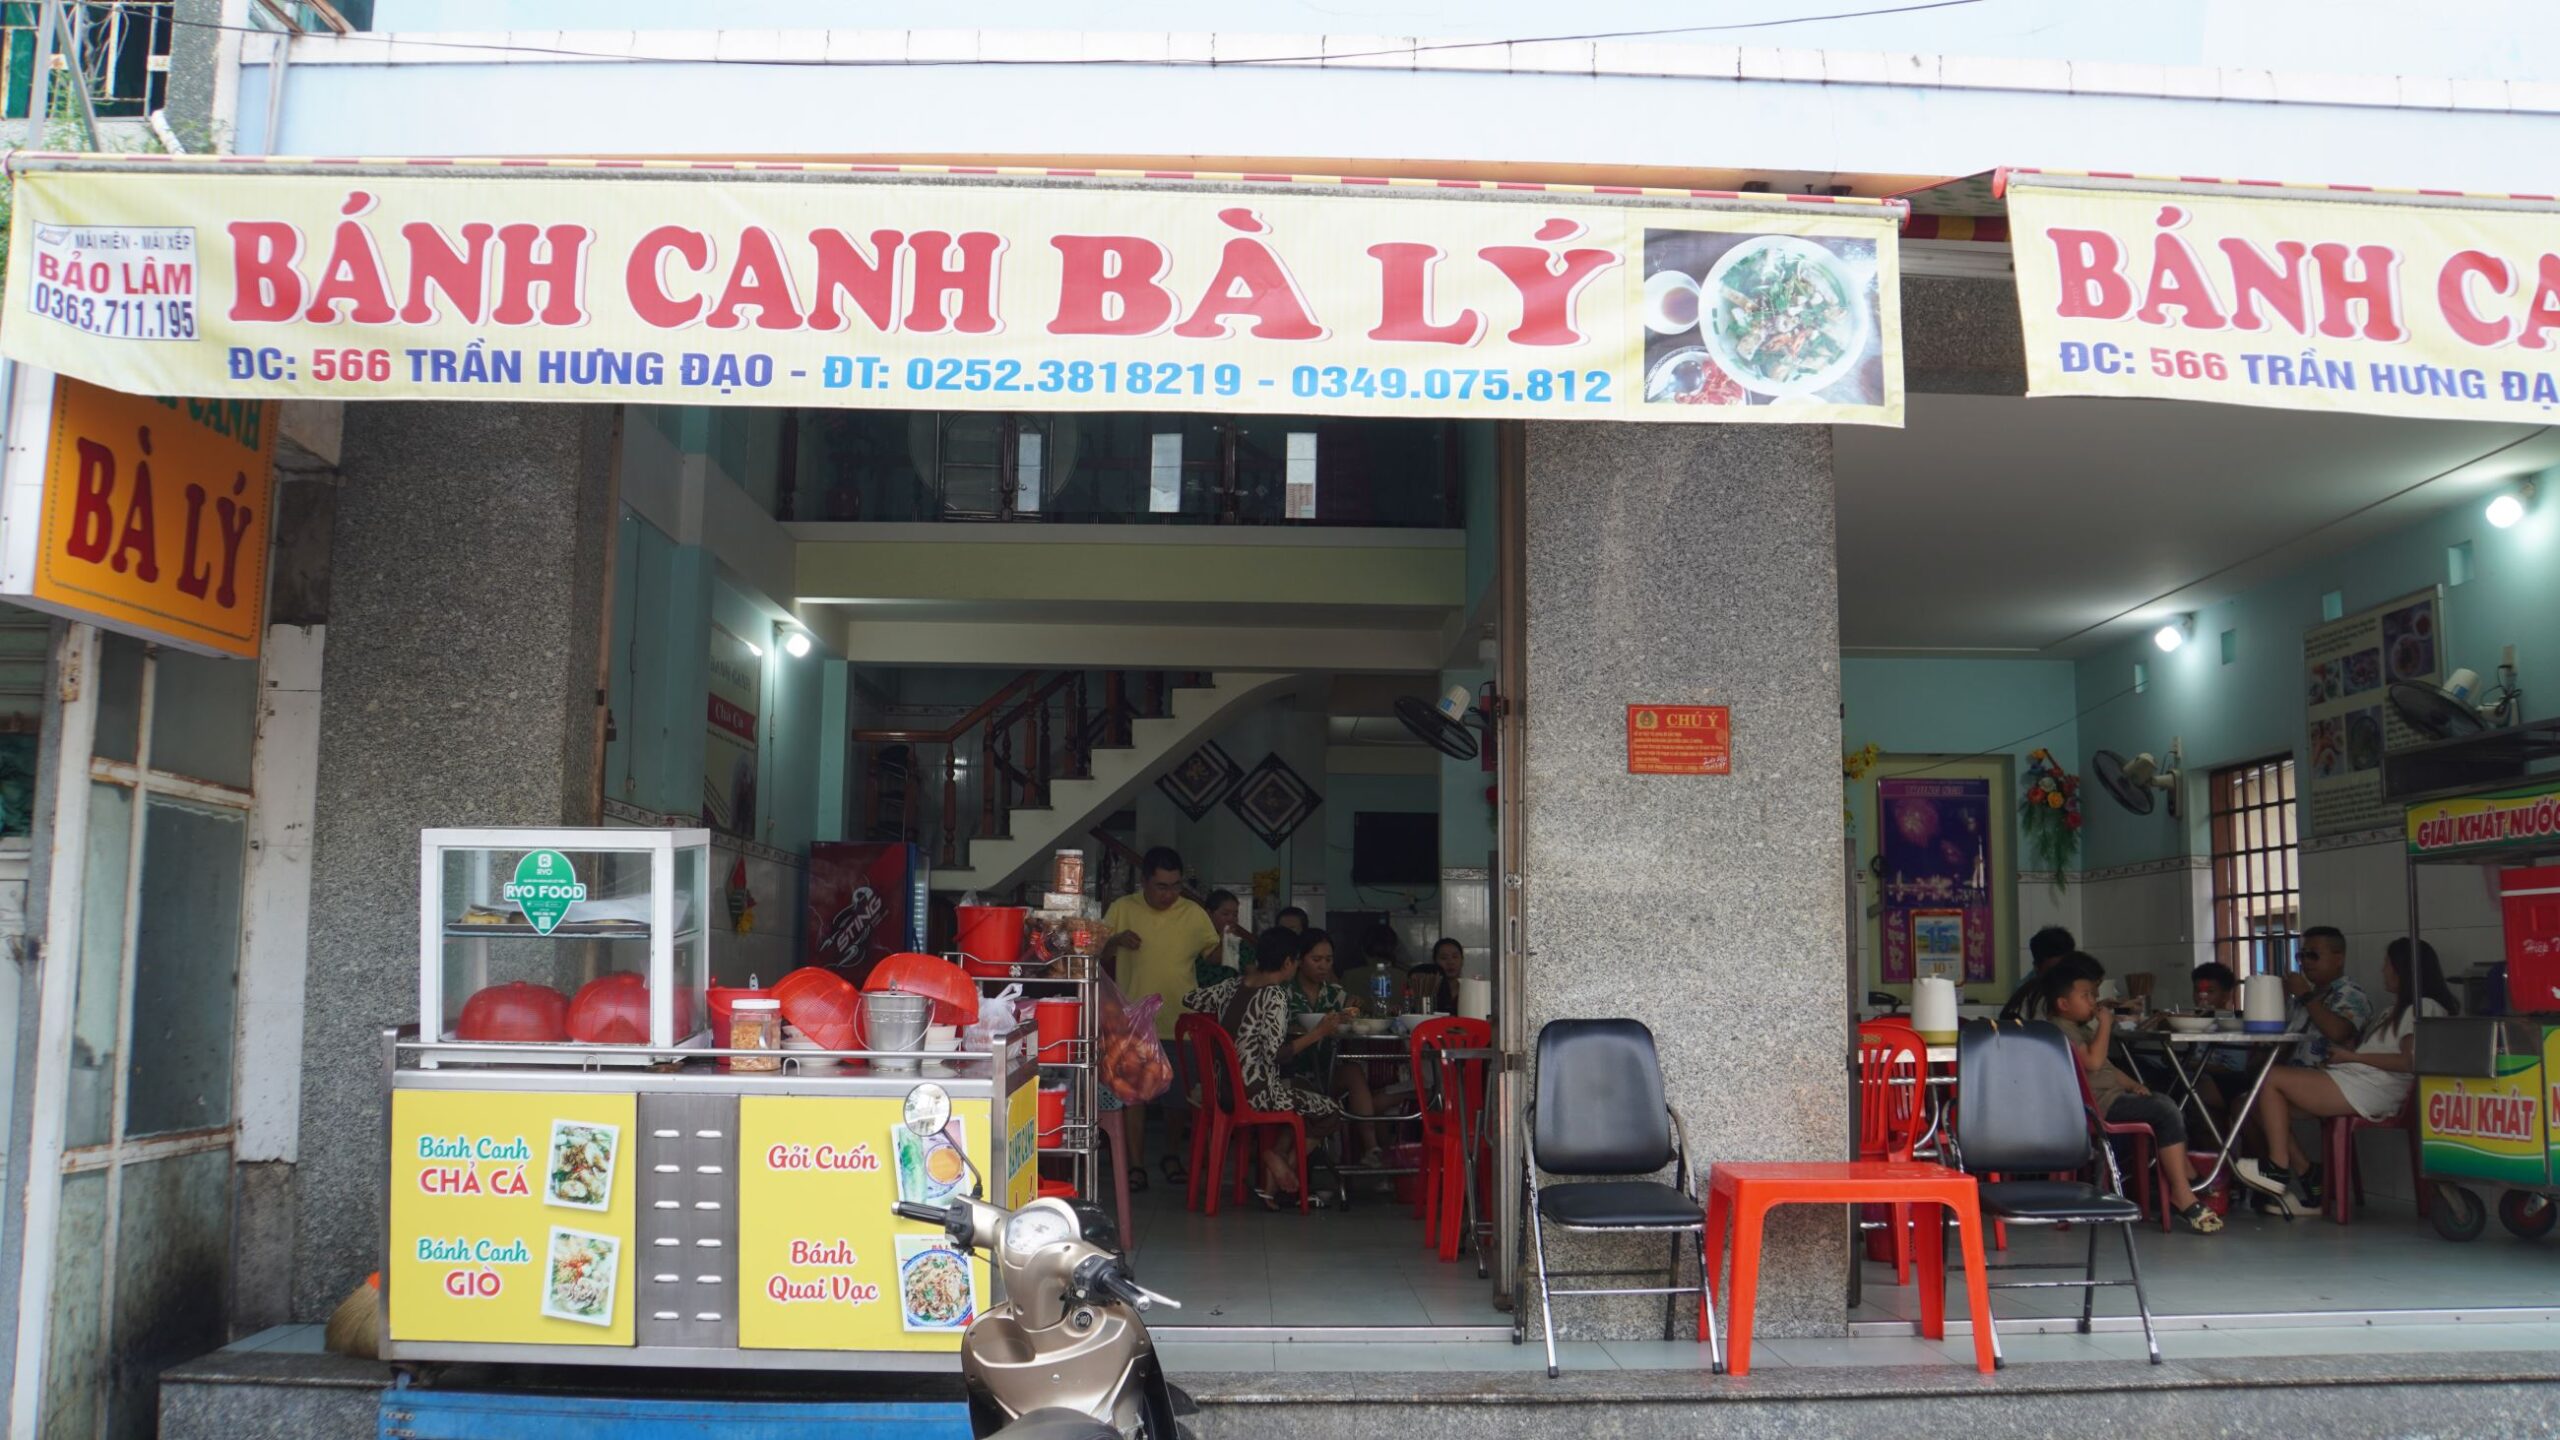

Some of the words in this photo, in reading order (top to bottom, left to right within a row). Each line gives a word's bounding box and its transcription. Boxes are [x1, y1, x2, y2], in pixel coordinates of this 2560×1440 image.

[38, 250, 109, 293] BẢO
[122, 256, 192, 295] LÂM
[227, 190, 592, 327] BÁNH
[625, 225, 1005, 334] CANH
[1045, 207, 1328, 341] BÀ
[1365, 217, 1621, 348] LÝ
[2046, 205, 2405, 343] BÁNH
[36, 282, 194, 338] 0363.711.195
[228, 346, 296, 381] ĐC:
[311, 348, 391, 382] 566
[406, 337, 521, 383] TRẦN
[539, 347, 664, 386] HƯNG
[679, 351, 774, 394] ĐẠO
[822, 355, 889, 390] ĐT:
[906, 356, 1241, 396] 0252.3818219
[1291, 364, 1613, 403] 0349.075.812
[2059, 341, 2136, 375] ĐC:
[2150, 347, 2229, 381] 566
[2241, 347, 2357, 391] TRẦN
[2370, 363, 2488, 400] HƯNG
[66, 425, 159, 583] BÀ
[176, 470, 252, 609] LÝ
[1666, 711, 1702, 727] CHÚ
[1707, 711, 1719, 727] Ý
[2417, 808, 2453, 848] GIẢI
[2457, 804, 2505, 841] KHÁT
[506, 885, 535, 898] RYO
[539, 886, 583, 899] FOOD
[2429, 1082, 2472, 1132] GIẢI
[2477, 1088, 2536, 1140] KHÁT
[419, 1136, 472, 1159] Bánh
[476, 1137, 530, 1160] Canh
[768, 1144, 811, 1169] Gỏi
[815, 1144, 880, 1170] Cuốn
[420, 1161, 481, 1193] CHẢ
[490, 1164, 529, 1195] CÁ
[418, 1238, 470, 1262] Bánh
[475, 1239, 529, 1263] Canh
[791, 1240, 856, 1265] Bánh
[445, 1266, 501, 1297] GIÒ
[768, 1275, 827, 1302] Quai
[831, 1276, 878, 1305] Vạc
